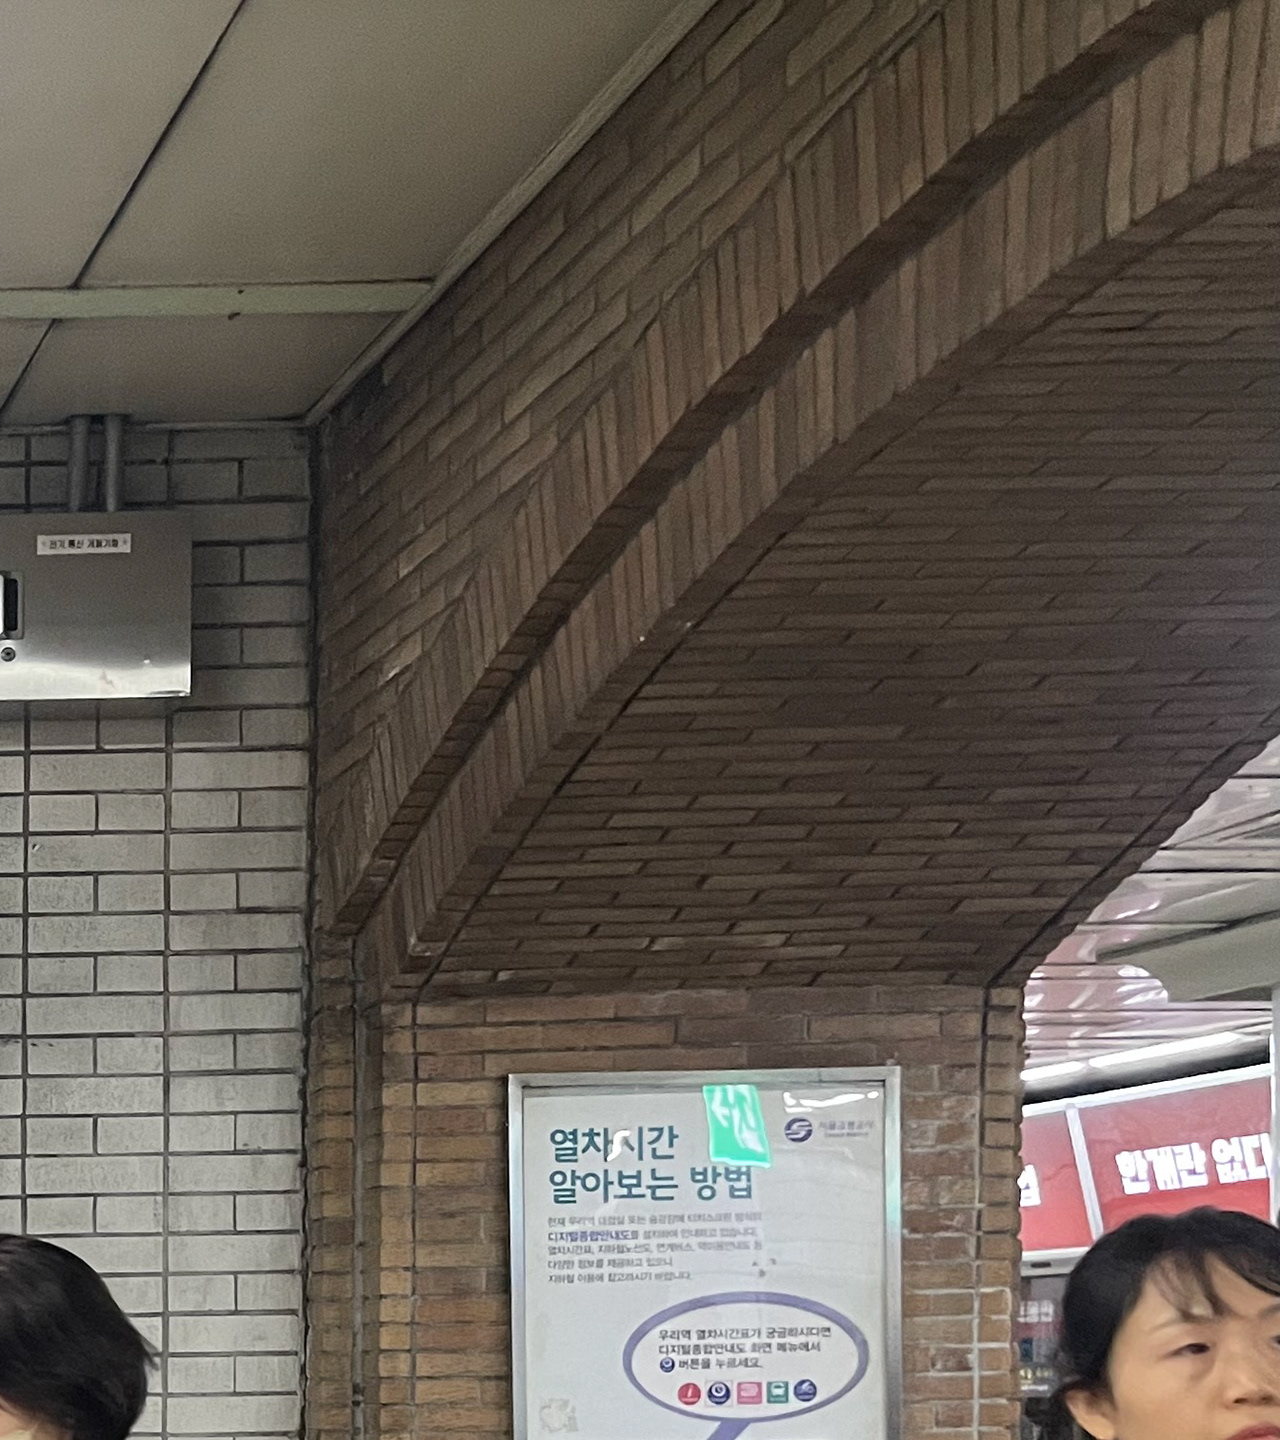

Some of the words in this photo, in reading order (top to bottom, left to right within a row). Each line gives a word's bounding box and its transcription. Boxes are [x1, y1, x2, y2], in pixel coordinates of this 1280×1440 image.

[550, 1125, 679, 1163] 열차시간
[549, 1168, 679, 1205] 알아보는
[690, 1166, 752, 1201] 방법
